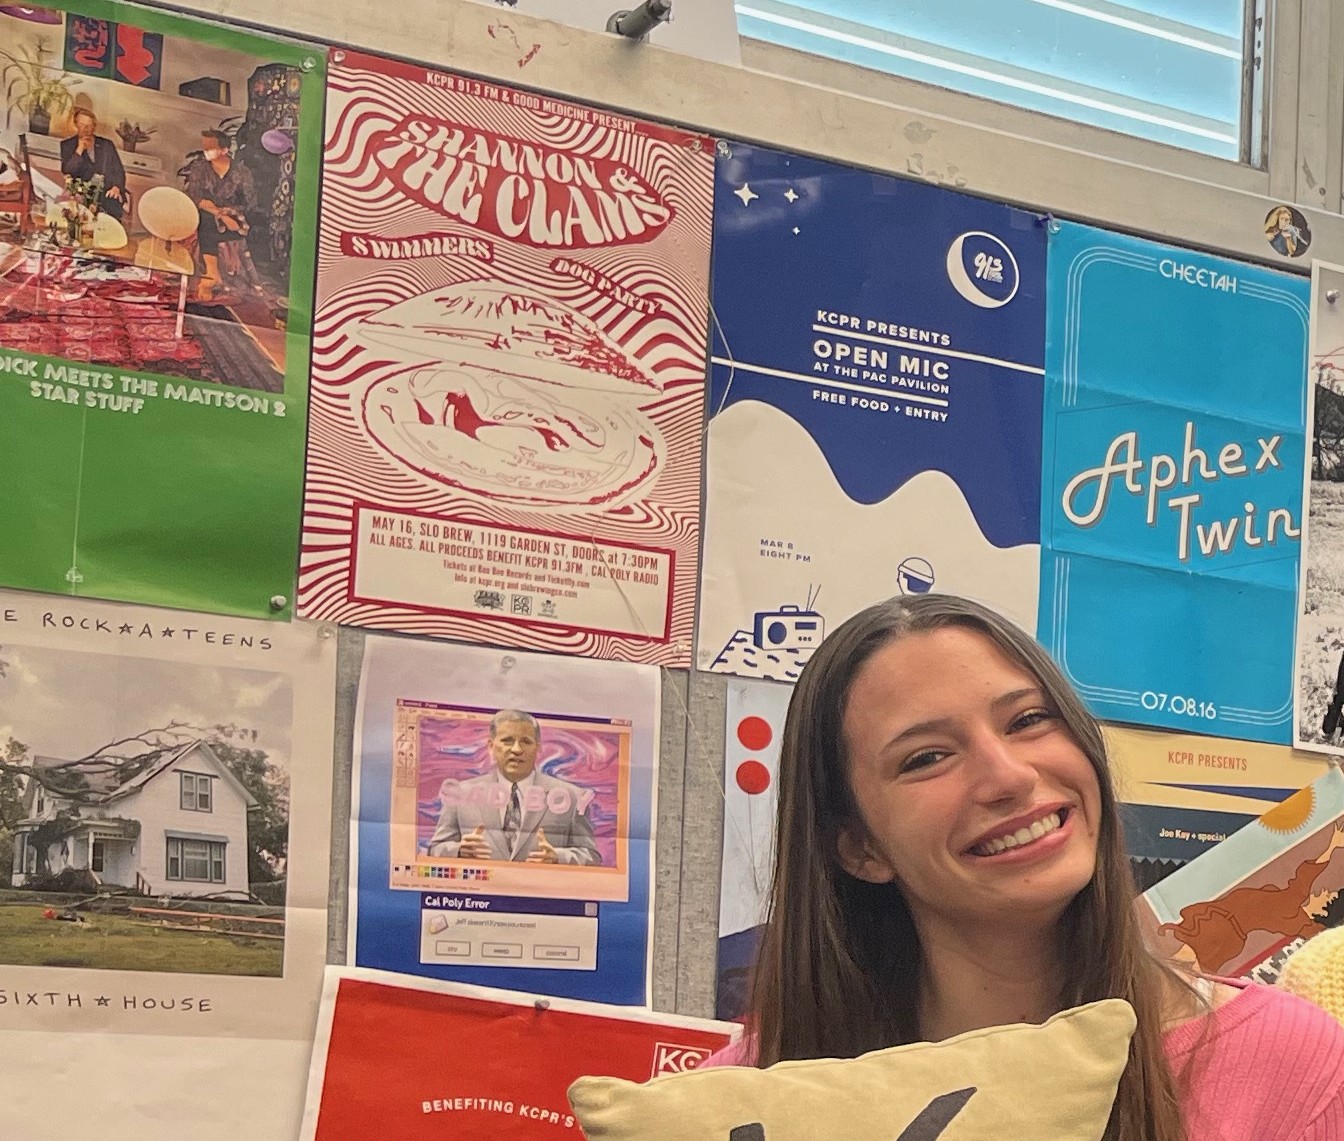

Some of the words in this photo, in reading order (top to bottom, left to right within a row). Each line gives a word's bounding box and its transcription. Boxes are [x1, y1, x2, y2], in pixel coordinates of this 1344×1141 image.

[426, 71, 455, 90] KCPR
[457, 80, 481, 96] 91.3
[484, 85, 499, 100] FM
[502, 90, 510, 102] &
[513, 93, 540, 110] GOOD
[542, 98, 590, 122] MEDICINE
[399, 120, 604, 190] SHANNON
[609, 167, 647, 195] &
[377, 136, 488, 225] THE
[495, 174, 671, 246] CLAMS
[352, 235, 492, 259] SWIMMERS
[554, 258, 597, 282] DOG
[597, 277, 664, 315] PARTY
[1158, 259, 1238, 294] CHEETAH
[817, 310, 860, 329] KCPR
[867, 320, 951, 346] PRESENTS
[813, 339, 888, 370] OPEN
[900, 355, 950, 380] MIC
[44, 363, 114, 389] MEETS
[120, 375, 158, 397] THE
[164, 383, 268, 415] MATTSON
[273, 401, 286, 417] 2
[813, 361, 829, 373] AT
[834, 364, 858, 379] THE
[862, 370, 887, 384] PAC
[891, 375, 950, 395] PAVILION
[30, 380, 79, 405] STAR
[84, 390, 145, 414] STUFF
[812, 390, 847, 406] FREE
[851, 397, 889, 413] FOOD
[905, 406, 949, 423] ENTRY
[1063, 421, 1282, 525] Aphex
[372, 515, 395, 532] MAY
[399, 519, 417, 538] 16,
[420, 523, 440, 538] SLO
[442, 526, 476, 545] BREW,
[480, 531, 507, 549] 1119
[510, 535, 551, 555] GARDEN
[572, 544, 606, 562] DOORS
[608, 551, 618, 564] at
[1168, 495, 1301, 562] Twin
[370, 532, 386, 546] ALL
[419, 539, 436, 553] ALL
[438, 542, 484, 561] PROCEEDS
[486, 548, 522, 565] BENEFIT
[525, 553, 548, 570] KCPR
[591, 563, 608, 579] CAL
[609, 566, 631, 582] POLY
[633, 570, 659, 586] RADIO
[42, 612, 112, 634] ROCK
[182, 628, 272, 650] TEENS
[1140, 691, 1218, 720] 07.08.16
[1168, 751, 1194, 765] KCPR
[1199, 755, 1248, 771] PRESENTS
[526, 785, 595, 816] BOY
[425, 897, 440, 907] Cal
[442, 898, 463, 910] Poly
[465, 899, 490, 909] Error
[124, 995, 213, 1012] HOUSE
[422, 1098, 514, 1114] BENEFITING
[519, 1106, 575, 1128] KCPR'S
